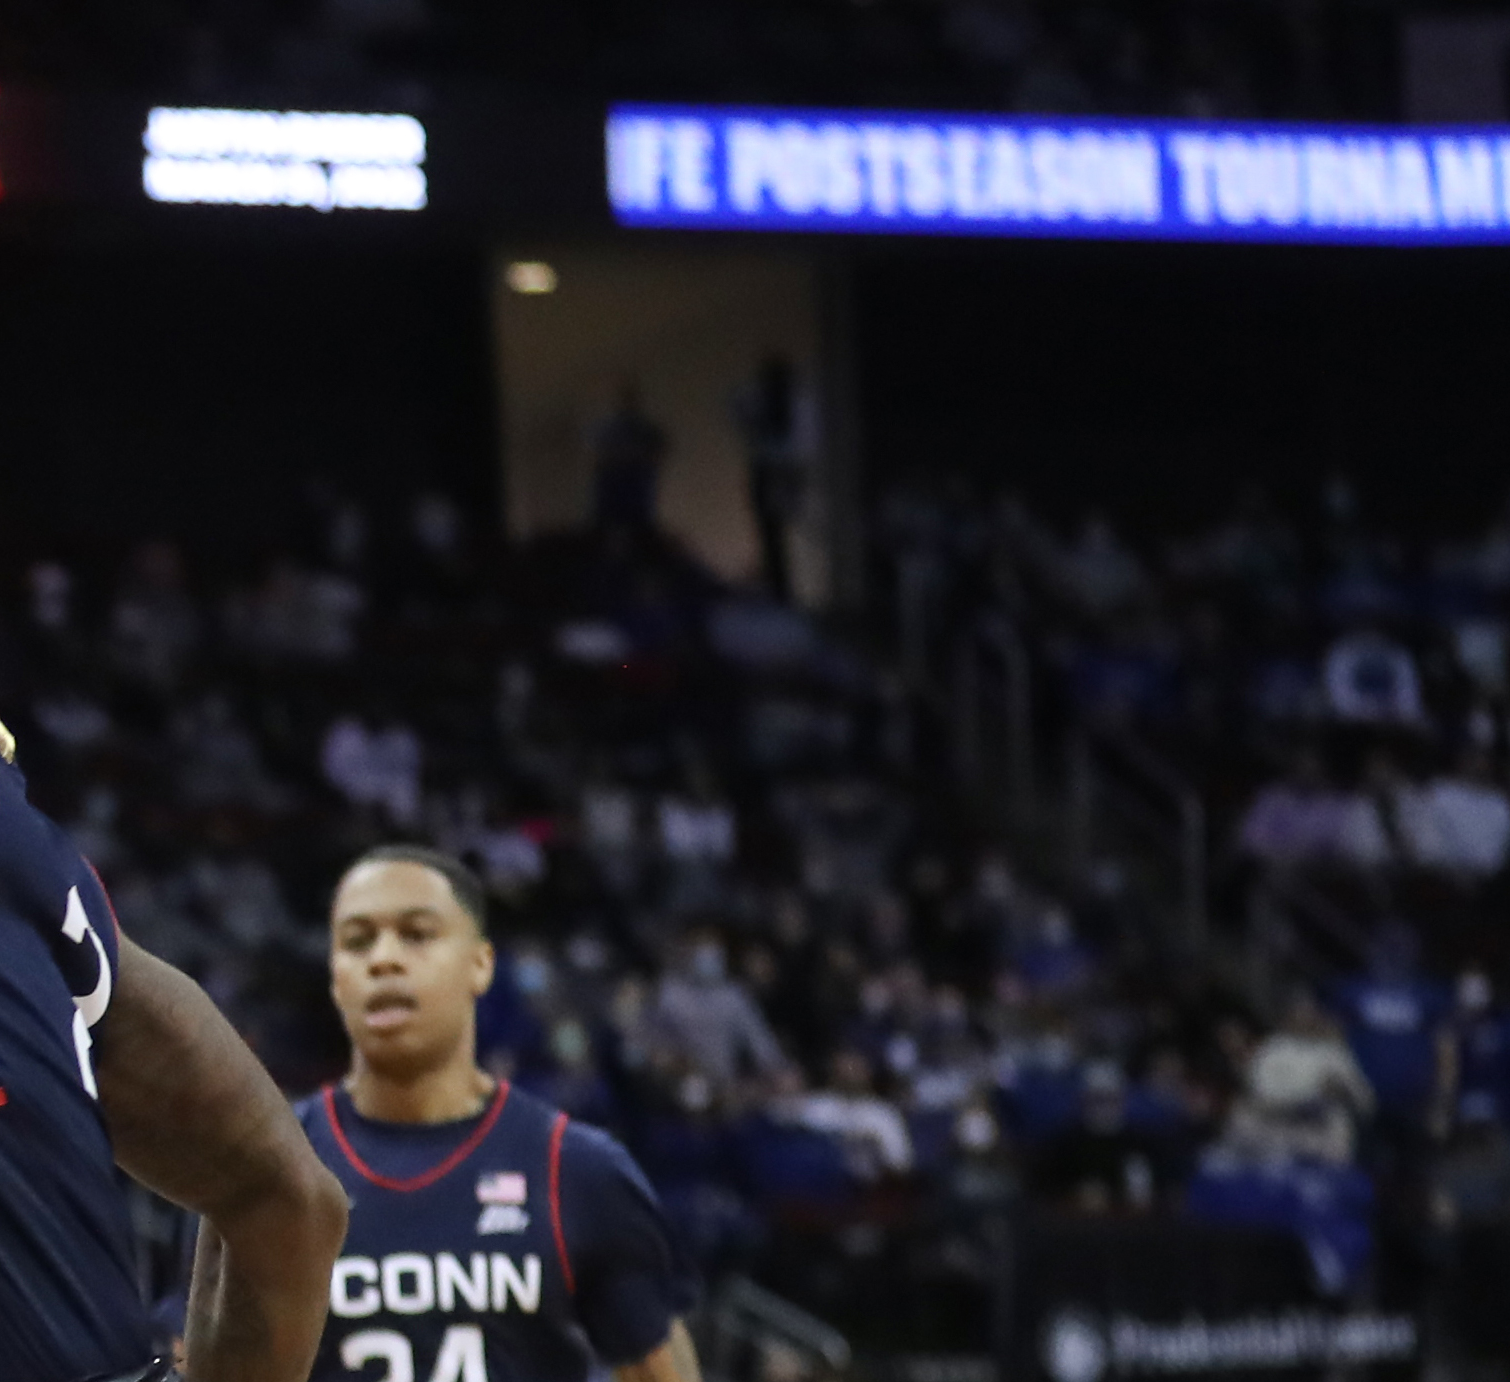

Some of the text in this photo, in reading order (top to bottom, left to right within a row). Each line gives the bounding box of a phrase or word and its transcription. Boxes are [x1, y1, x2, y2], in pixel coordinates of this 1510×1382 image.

[724, 117, 1161, 224] POSTSEASON
[1164, 130, 1510, 229] TOURNAM
[330, 1250, 543, 1319] CONN
